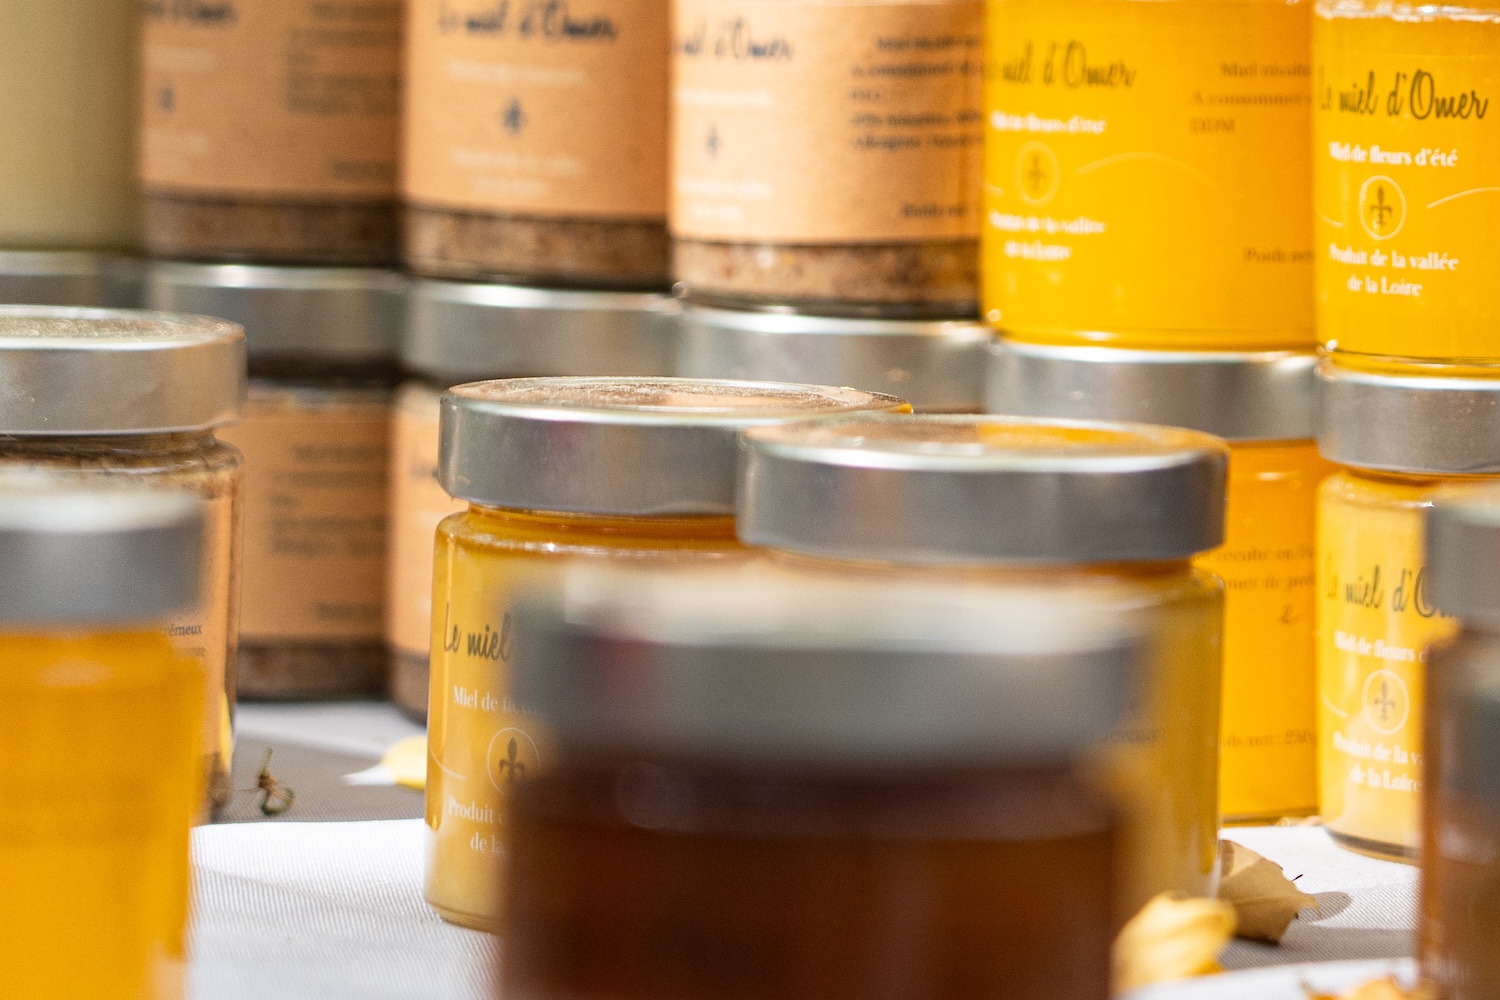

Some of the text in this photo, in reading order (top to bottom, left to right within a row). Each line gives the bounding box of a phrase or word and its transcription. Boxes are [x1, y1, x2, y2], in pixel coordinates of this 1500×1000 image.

[1339, 69, 1378, 115] miel
[1387, 68, 1489, 120] d'Omer
[1415, 147, 1459, 167] d'été
[1409, 251, 1459, 271] vallée
[1381, 275, 1423, 297] Loire
[163, 623, 203, 637] rémeux
[444, 602, 460, 653] Le
[467, 611, 511, 662] miel
[453, 685, 478, 709] Miel
[481, 692, 498, 711] de
[449, 796, 493, 823] Produit
[470, 832, 487, 852] de
